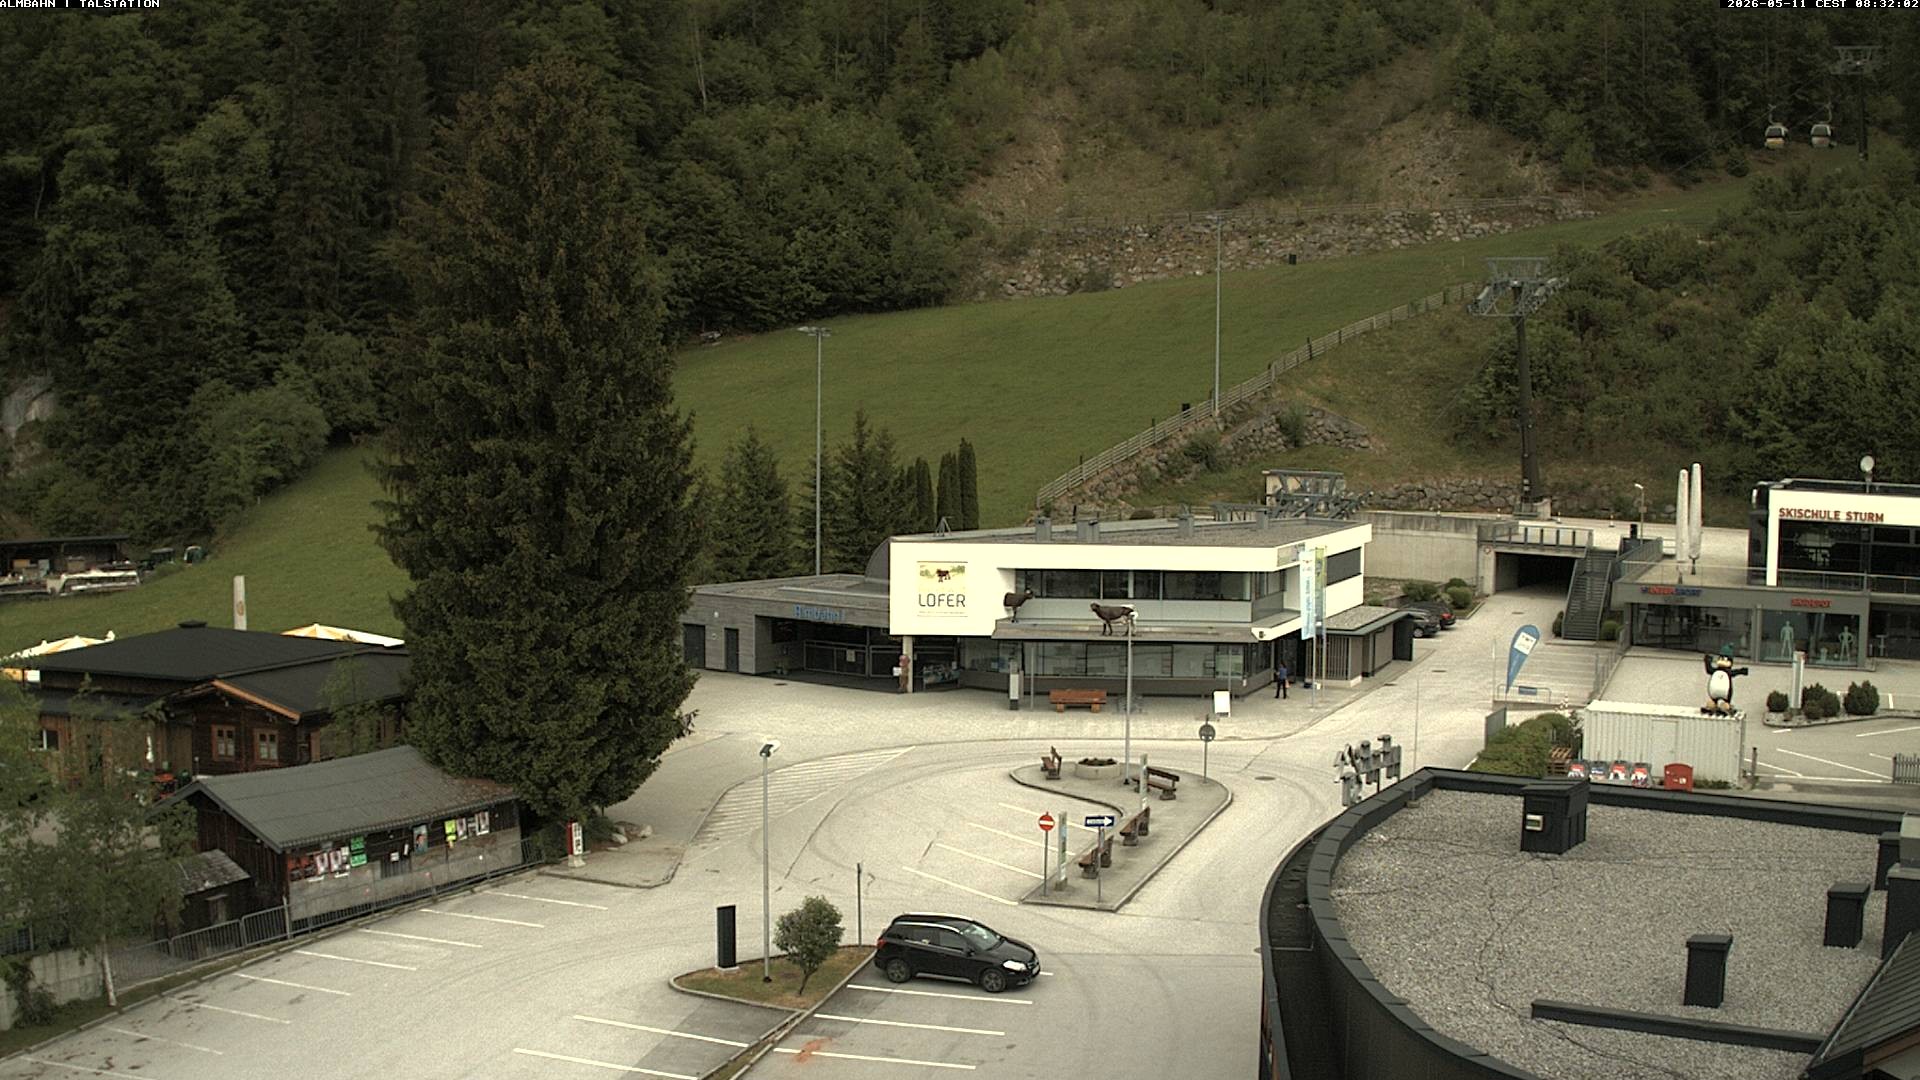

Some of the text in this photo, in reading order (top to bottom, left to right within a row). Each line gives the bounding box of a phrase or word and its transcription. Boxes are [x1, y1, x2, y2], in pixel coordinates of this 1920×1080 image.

[1779, 507, 1885, 523] SKISCHULE STURM
[918, 593, 966, 607] LOFER
